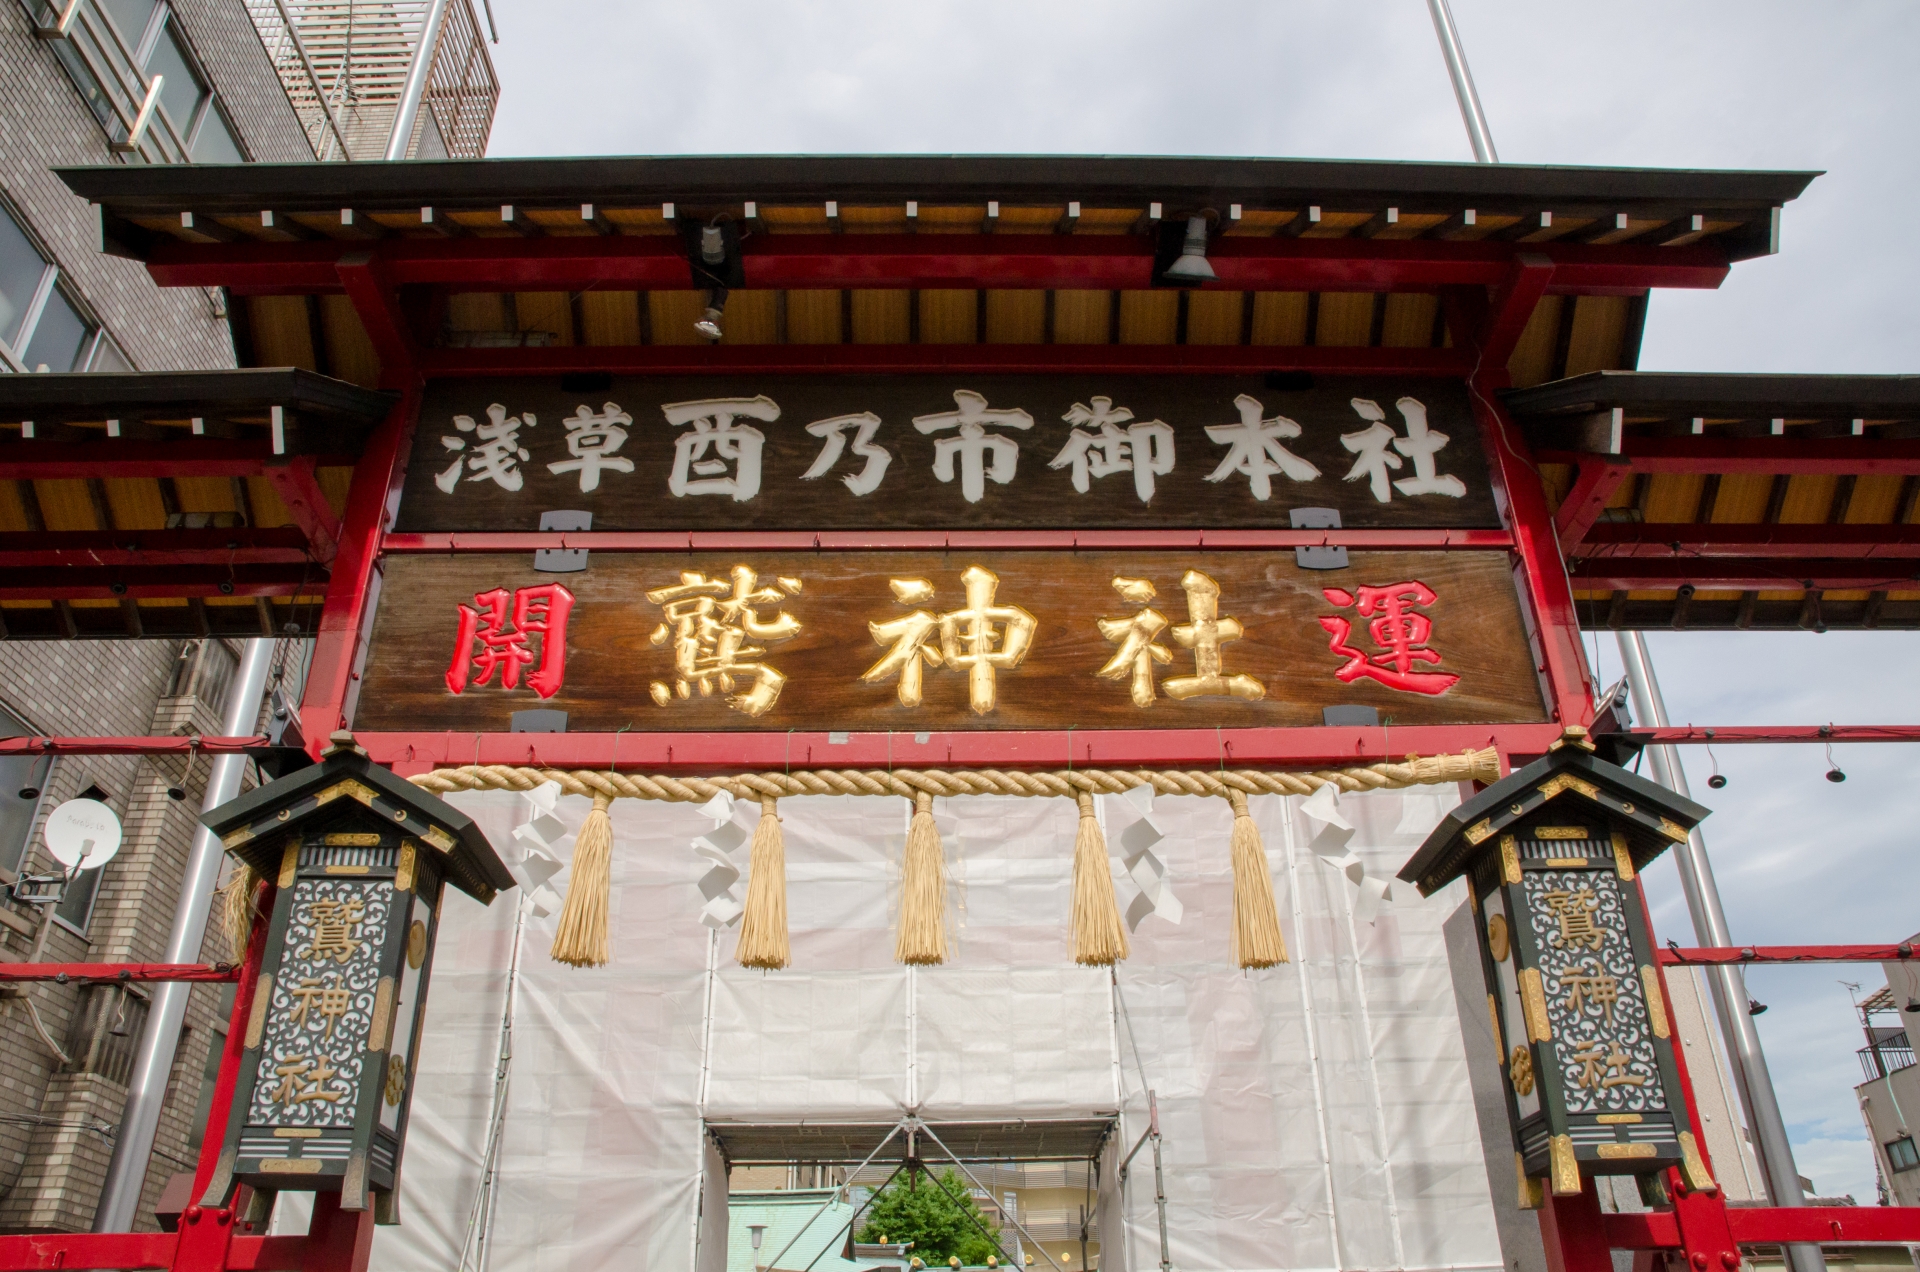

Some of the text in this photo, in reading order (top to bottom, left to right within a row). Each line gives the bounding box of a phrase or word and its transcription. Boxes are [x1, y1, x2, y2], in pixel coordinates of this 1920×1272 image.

[272, 896, 366, 1107] 鷲神社
[1543, 888, 1645, 1092] 鷲神社
